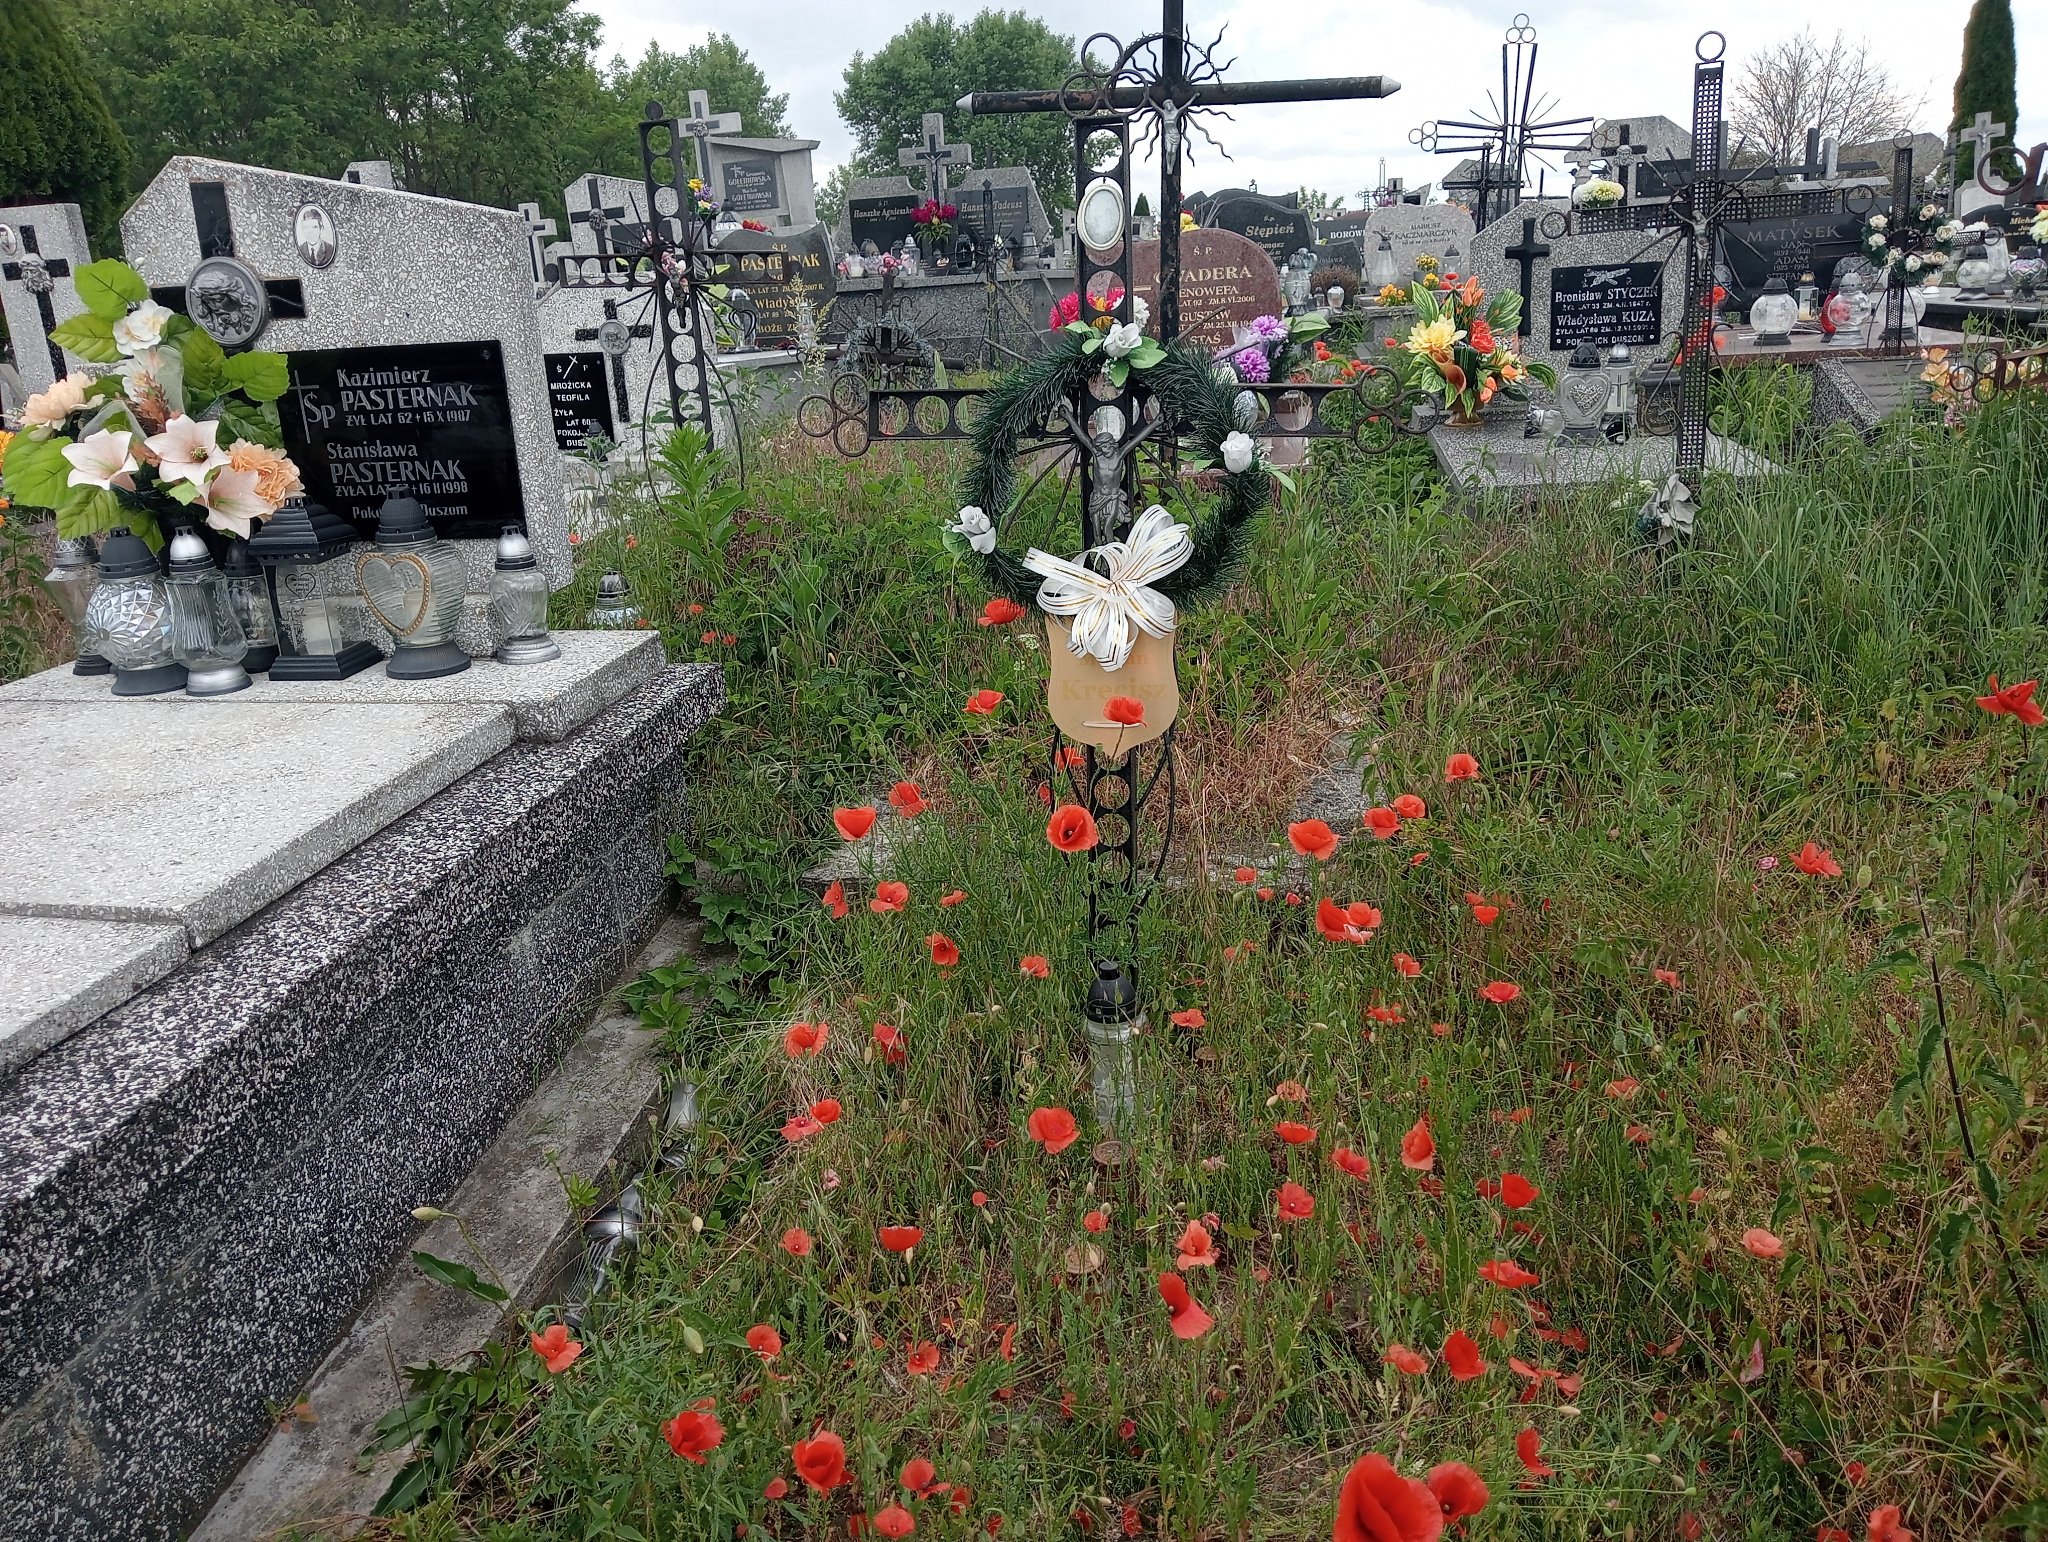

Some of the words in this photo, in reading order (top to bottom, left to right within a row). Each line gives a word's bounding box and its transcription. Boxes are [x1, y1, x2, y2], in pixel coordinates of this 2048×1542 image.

[1245, 222, 1295, 237] Stępień
[1410, 222, 1441, 230] MARIUSZ
[1747, 225, 1843, 242] MATYSEK
[1395, 229, 1458, 240] KACZMARCZYK
[740, 253, 820, 271] PASTENAK
[1179, 285, 1239, 298] ENOWEFA
[1554, 290, 1603, 303] Bronisław
[1556, 312, 1617, 328] Władysława
[1621, 310, 1656, 323] KUZA
[1190, 332, 1221, 345] STAŚ
[336, 366, 431, 387] Kazimierz
[340, 384, 479, 412] PASTERNAK
[556, 393, 590, 402] TEOFILA
[370, 412, 393, 426] LAT
[397, 412, 412, 424] 62
[422, 411, 434, 423] 15
[436, 410, 445, 422] X
[554, 408, 574, 417] ŻYŁA
[566, 419, 579, 427] LAT
[326, 440, 418, 459] Stanisława
[329, 459, 466, 484] PASTERNAK
[370, 484, 391, 496] LAT
[420, 482, 431, 494] 16
[442, 481, 469, 493] 1998
